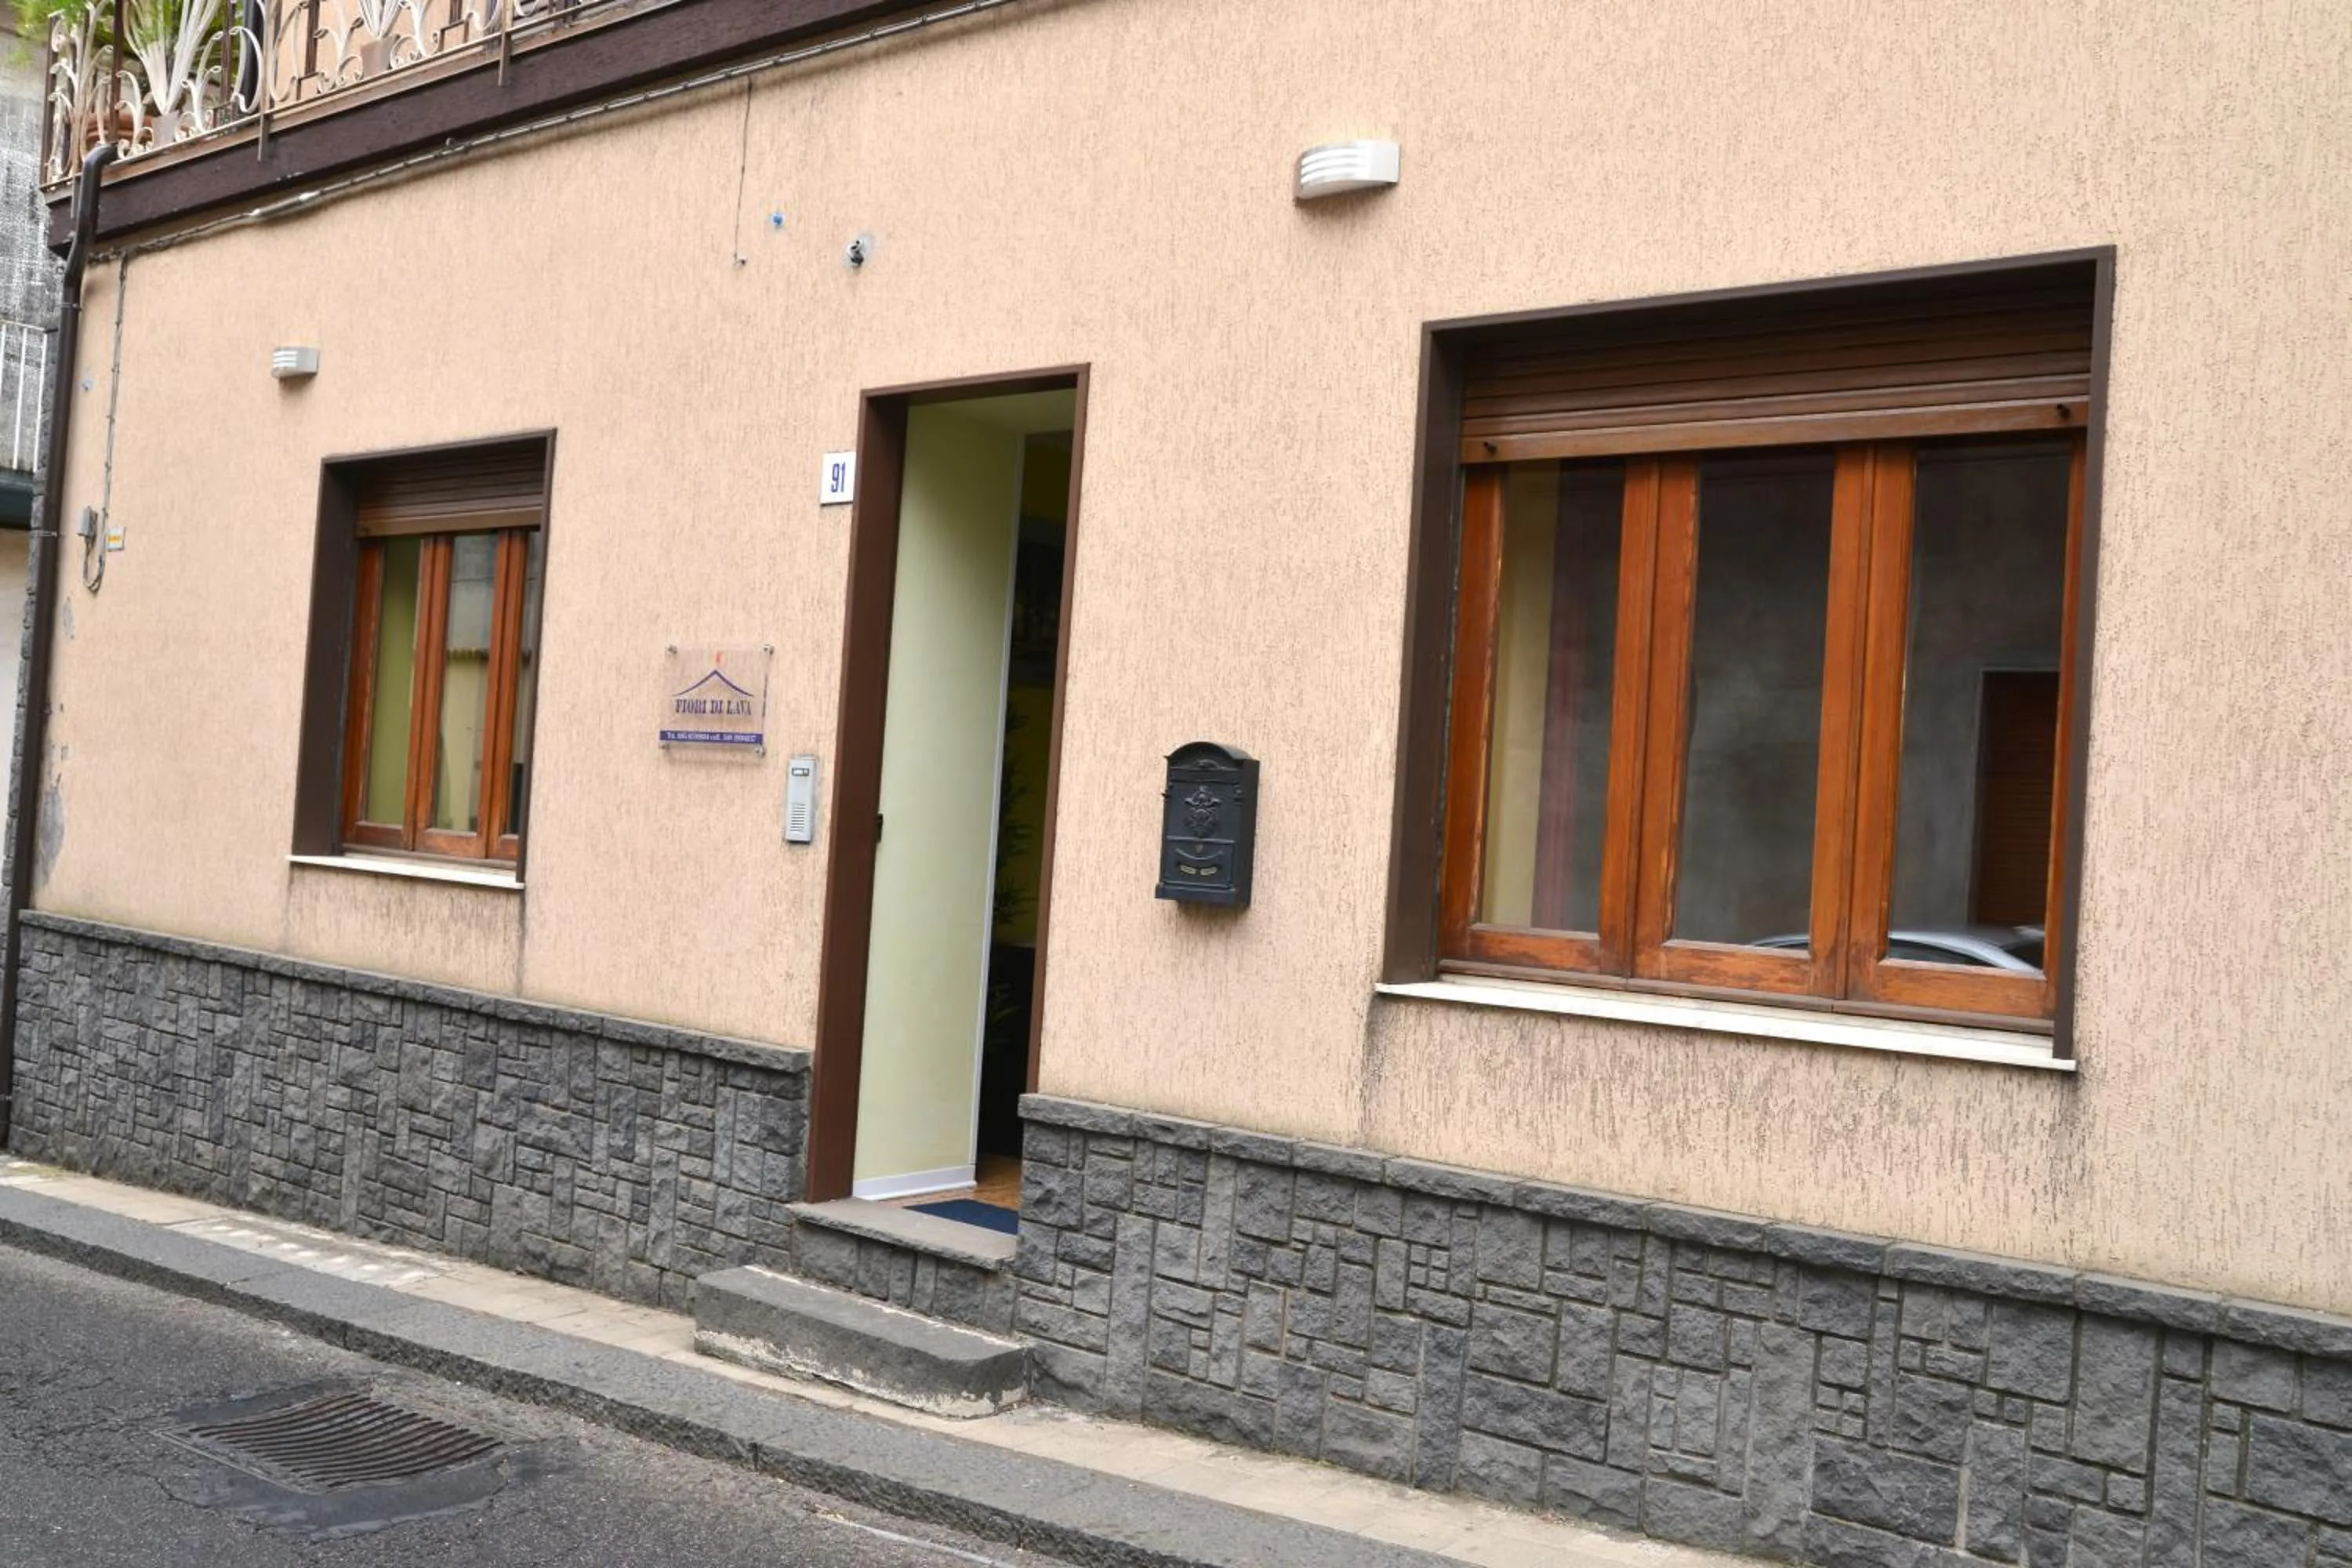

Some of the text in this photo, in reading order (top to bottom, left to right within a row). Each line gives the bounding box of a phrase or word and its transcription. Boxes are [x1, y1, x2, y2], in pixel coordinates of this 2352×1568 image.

[831, 461, 846, 492] 91
[675, 699, 752, 716] FIORI DI LAVA
